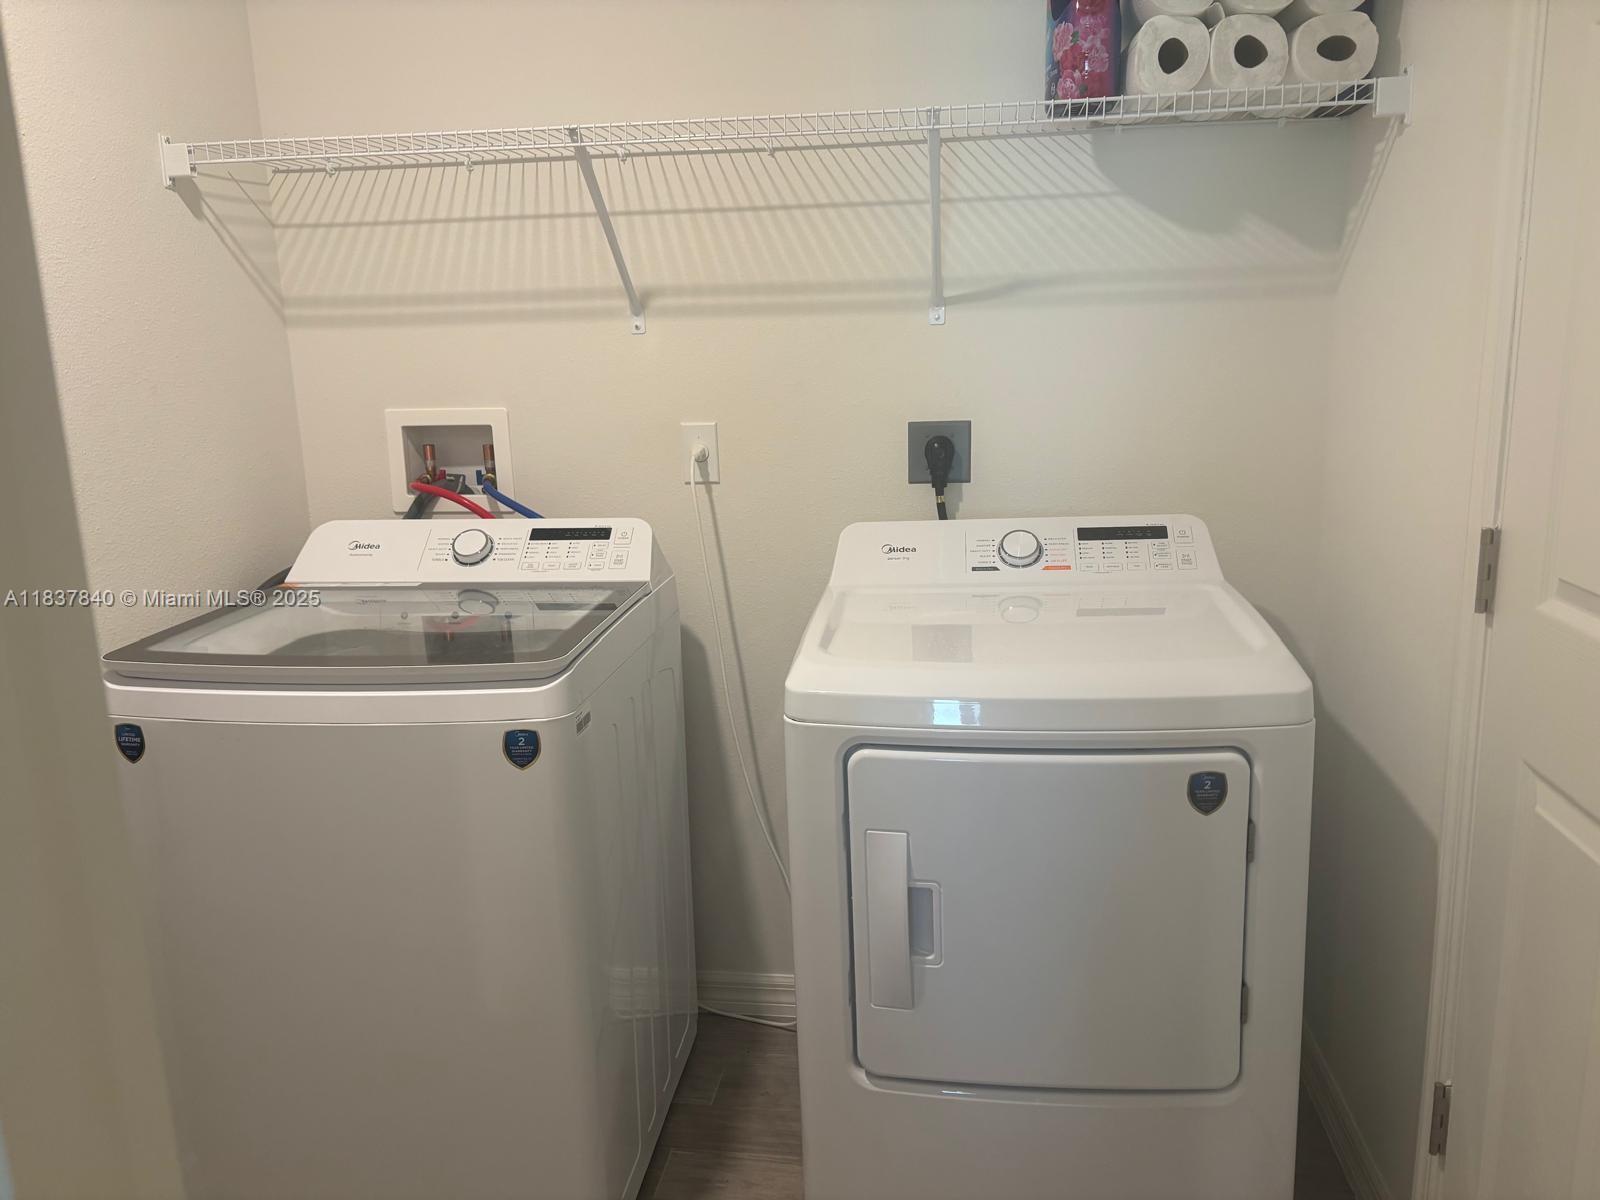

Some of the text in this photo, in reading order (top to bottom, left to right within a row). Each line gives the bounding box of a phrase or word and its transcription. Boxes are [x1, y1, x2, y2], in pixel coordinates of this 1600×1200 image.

[348, 541, 381, 551] Midea
[881, 543, 917, 554] Midea
[518, 737, 525, 746] 2
[1203, 780, 1212, 789] 2
